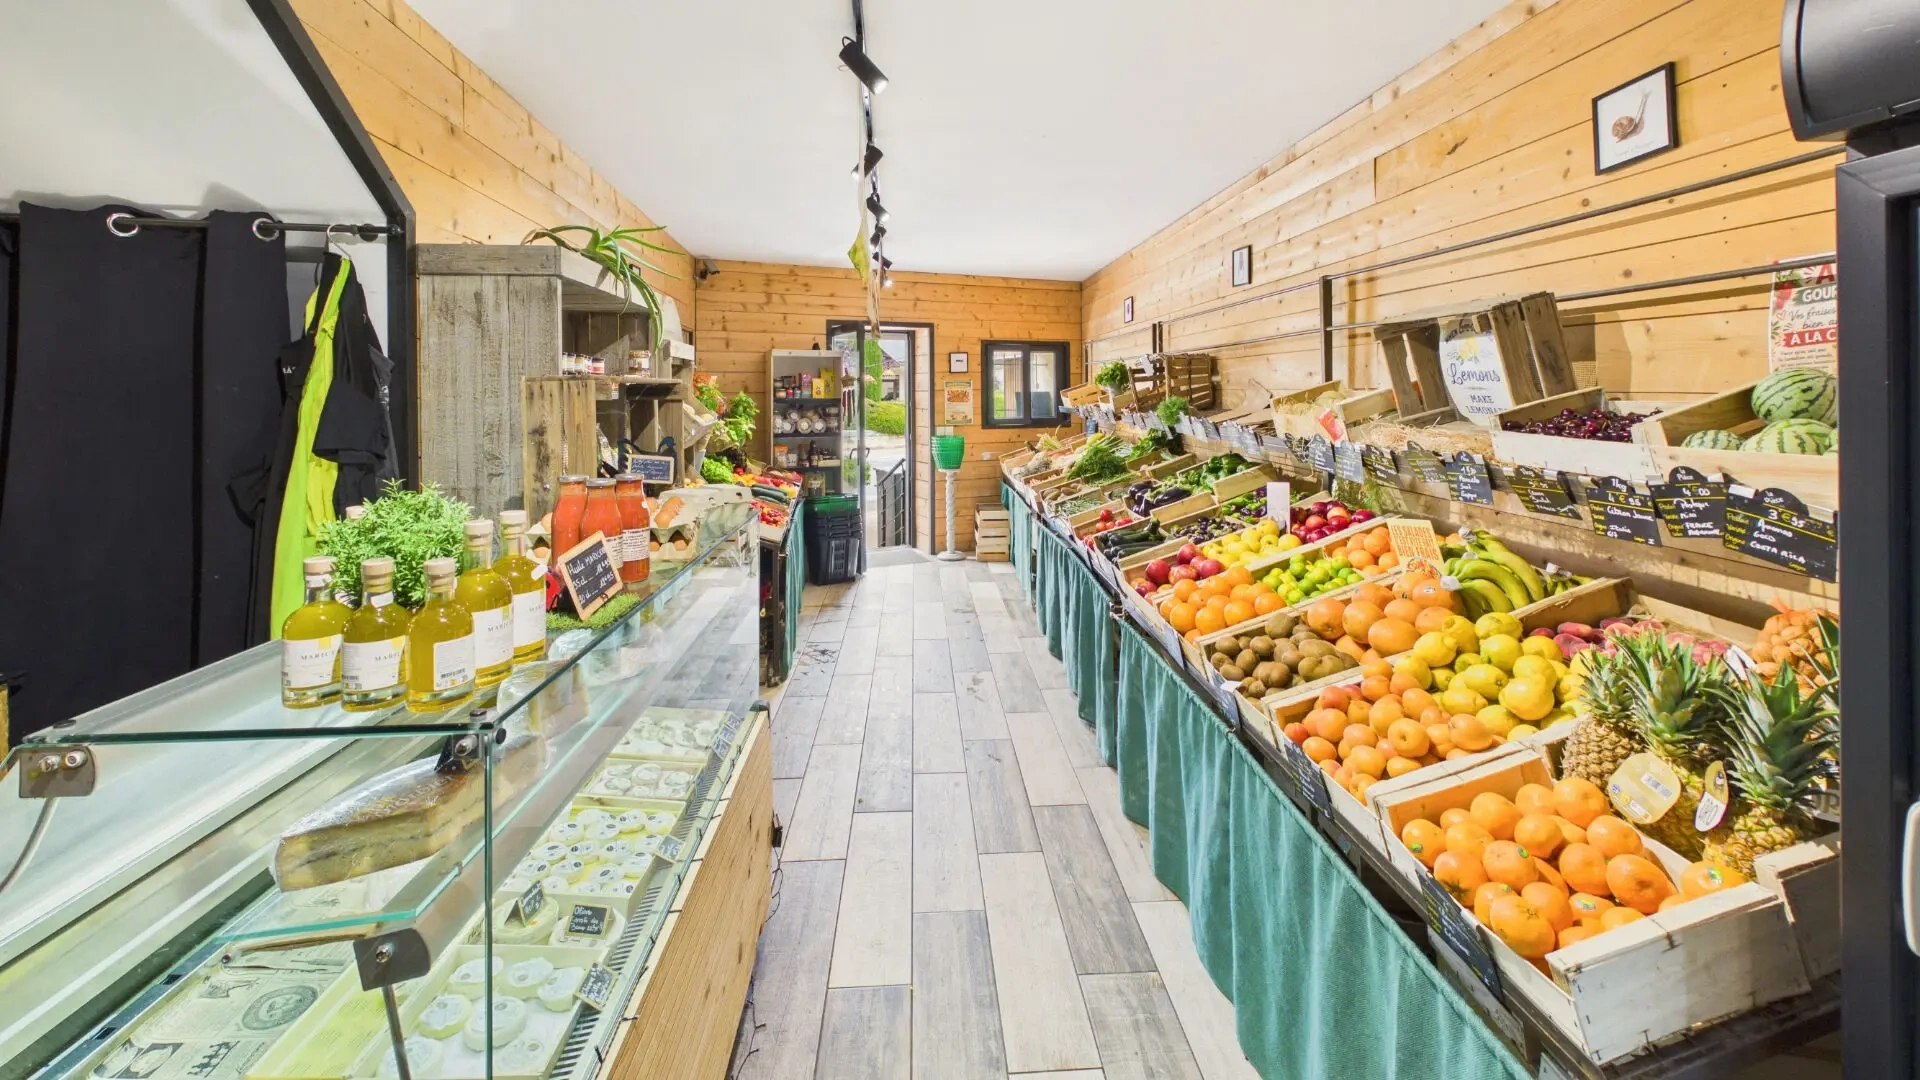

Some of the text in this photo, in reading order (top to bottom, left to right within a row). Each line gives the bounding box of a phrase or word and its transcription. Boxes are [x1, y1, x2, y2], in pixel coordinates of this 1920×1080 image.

[1804, 331, 1823, 344] LA
[1470, 394, 1495, 404] MAKE
[1610, 478, 1627, 493] 1kg
[1750, 541, 1778, 554] COSTA
[567, 559, 585, 575] Huile
